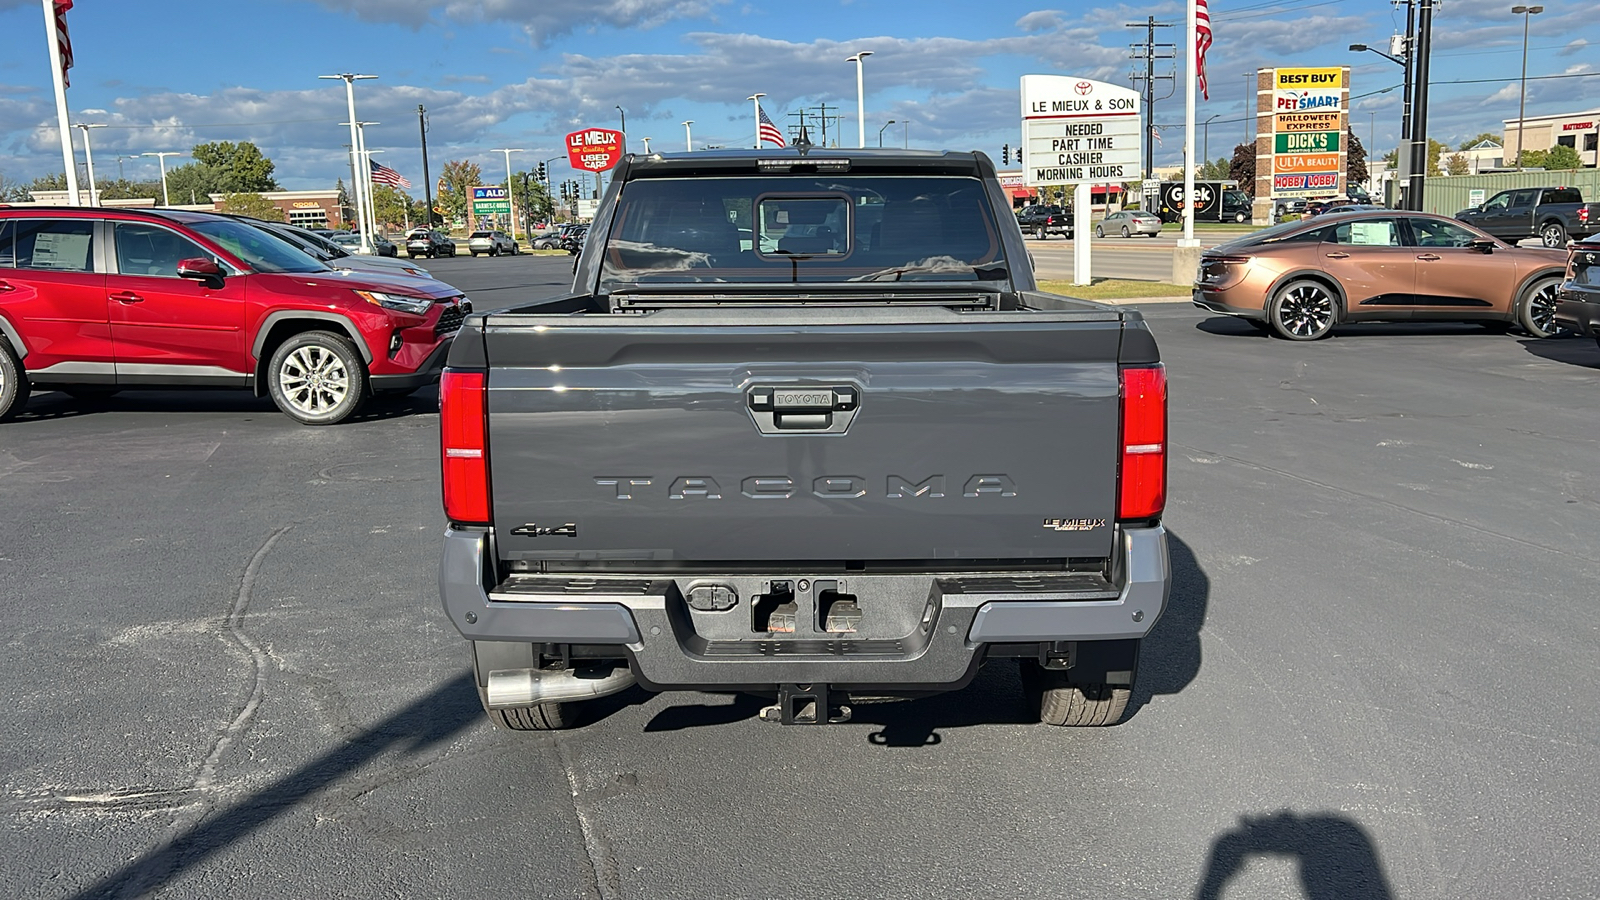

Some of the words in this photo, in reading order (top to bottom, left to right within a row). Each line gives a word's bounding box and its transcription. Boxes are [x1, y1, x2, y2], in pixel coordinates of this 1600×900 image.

[1280, 74, 1309, 83] BEST
[1311, 74, 1337, 82] BUY
[1032, 102, 1046, 112] LE
[1052, 100, 1089, 111] MIEUX
[1094, 100, 1102, 110] &
[1108, 98, 1134, 109] SON
[1066, 124, 1103, 136] NEEDED
[571, 134, 582, 146] LE
[584, 131, 616, 145] MIEUX
[1052, 139, 1080, 151] PART
[1087, 138, 1113, 150] TIME
[1287, 133, 1327, 148] DICK'S
[581, 154, 610, 162] USED
[1059, 152, 1103, 165] CASHIER
[1279, 157, 1305, 167] ULTA
[1307, 158, 1337, 166] BEAUTY
[584, 161, 607, 169] CARS
[1037, 168, 1083, 180] MORNING
[1089, 166, 1123, 178] HOURS
[1275, 176, 1305, 188] HOBBY
[1308, 174, 1336, 186] LOBBY
[777, 394, 830, 404] TOYOTA
[594, 475, 1017, 499] TACOMA
[510, 522, 577, 537] 4x4
[1043, 519, 1060, 527] LE
[1062, 519, 1105, 527] MIEUX
